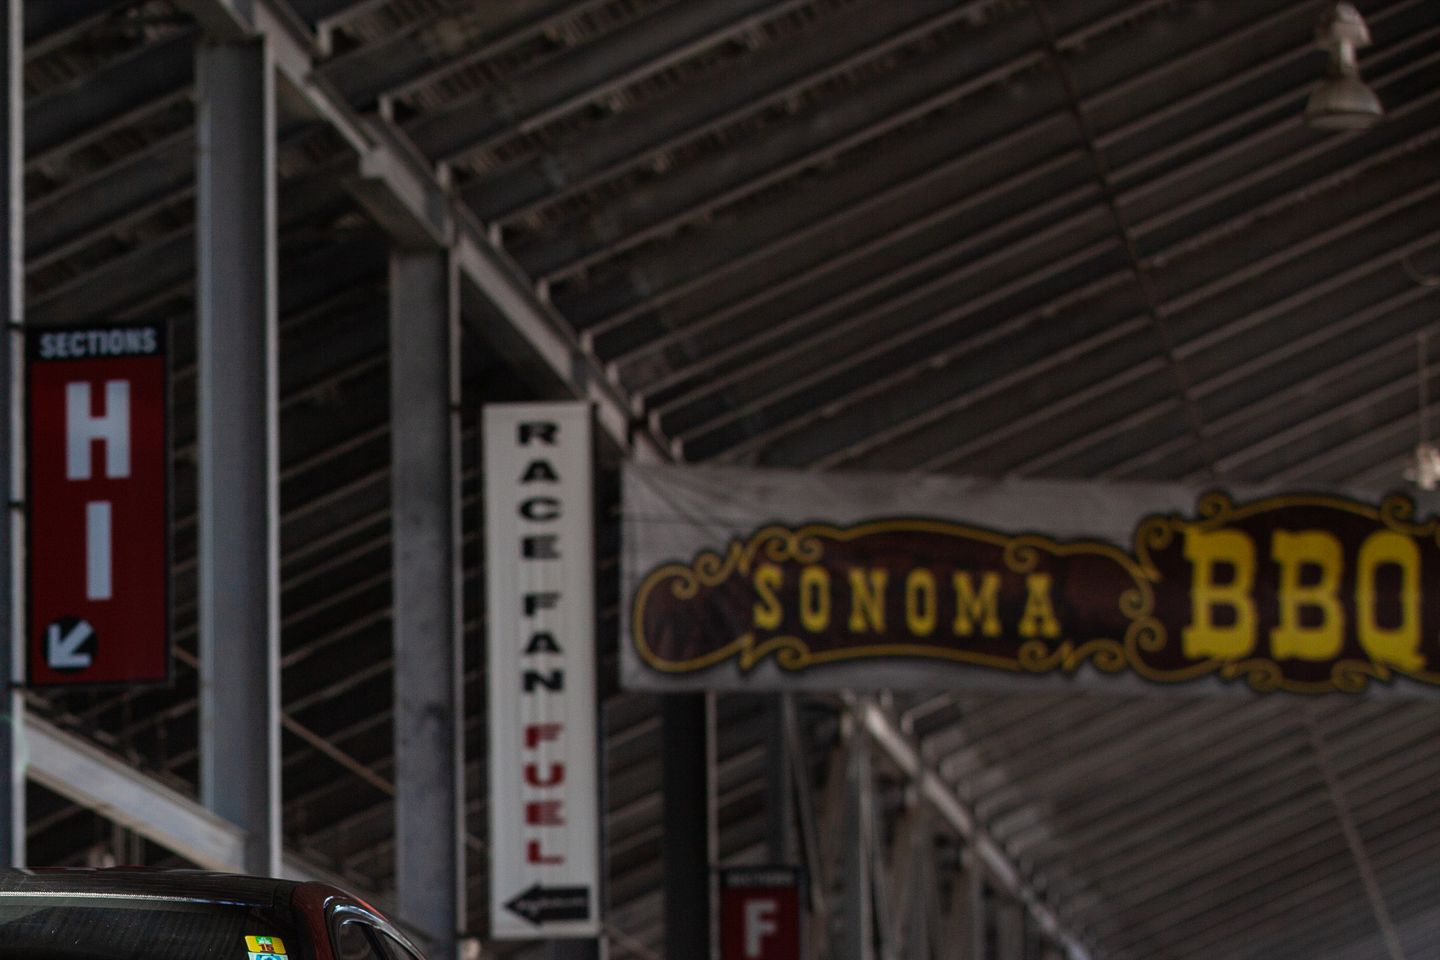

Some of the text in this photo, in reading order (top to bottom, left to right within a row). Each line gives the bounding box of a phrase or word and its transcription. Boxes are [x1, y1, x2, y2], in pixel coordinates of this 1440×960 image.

[40, 327, 157, 359] SECTIONS
[66, 379, 130, 481] H
[86, 501, 111, 600] I
[754, 530, 1425, 668] SONOMA BBQ
[517, 420, 565, 866] RACE FAN FUEL
[743, 898, 779, 960] F
